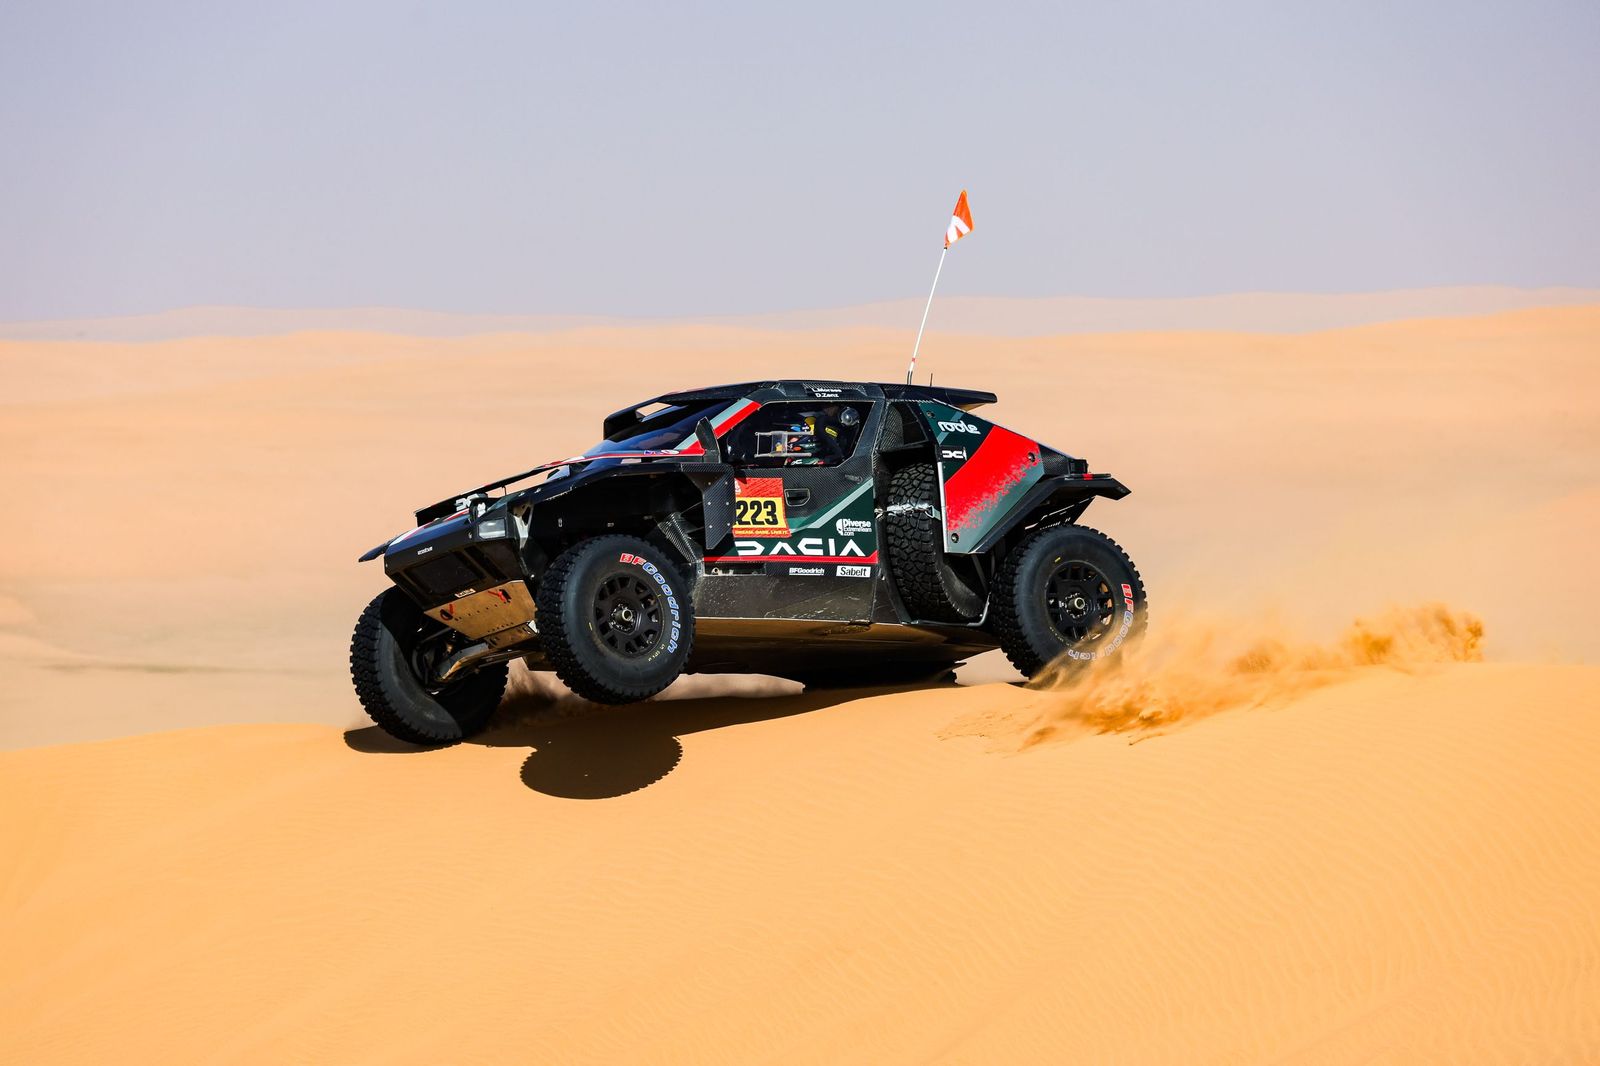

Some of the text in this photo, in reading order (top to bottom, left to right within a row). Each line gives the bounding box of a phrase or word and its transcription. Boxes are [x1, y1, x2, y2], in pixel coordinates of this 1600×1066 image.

[735, 500, 778, 526] 223
[843, 518, 872, 528] Diverse
[734, 537, 866, 557] DACIA
[788, 567, 825, 575] BFGoodrich
[840, 565, 867, 577] Sabelt
[619, 552, 681, 654] BFGoodrich
